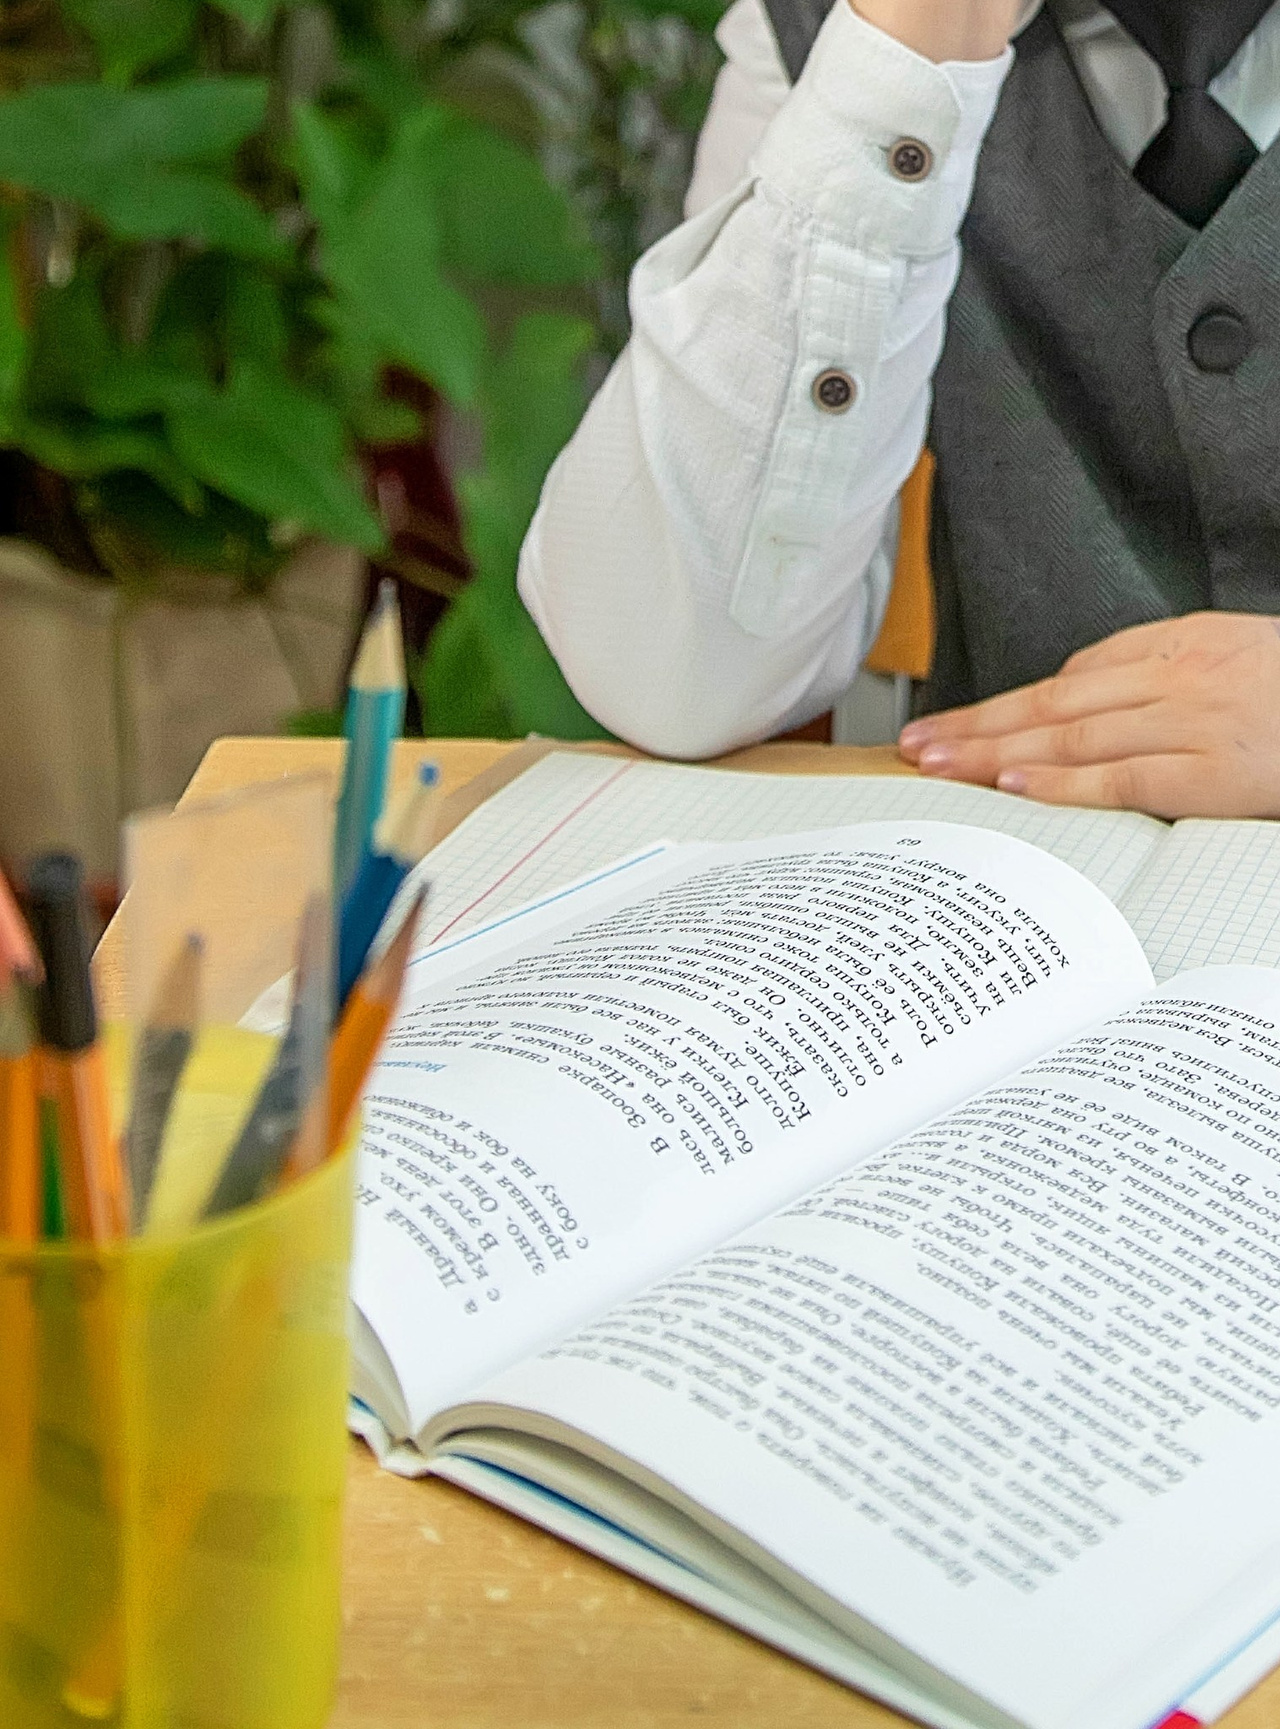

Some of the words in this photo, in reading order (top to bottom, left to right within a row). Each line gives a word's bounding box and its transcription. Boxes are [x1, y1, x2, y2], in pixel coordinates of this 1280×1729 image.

[896, 838, 922, 847] 63
[815, 859, 859, 868] была
[862, 861, 934, 884] Копуша
[903, 858, 968, 881] вокруг
[758, 892, 802, 901] раза
[841, 880, 915, 907] Копуша
[936, 880, 950, 888] а
[974, 882, 1007, 904] она
[807, 897, 879, 921] первого
[825, 889, 919, 925] положили
[889, 877, 994, 936] незнакомая,
[956, 887, 1022, 936] укусит,
[761, 912, 831, 933] достать
[814, 911, 880, 939] вышло
[924, 905, 998, 966] Копушу.
[704, 938, 757, 954] сопел.
[835, 931, 886, 962] улей,
[883, 941, 908, 957] не
[887, 924, 931, 952] Для
[926, 925, 984, 978] землю,
[1013, 907, 1070, 969] ходила
[677, 959, 701, 968] не
[772, 941, 820, 964] тоже
[825, 944, 872, 977] была
[997, 938, 1038, 989] Вещь
[1024, 945, 1051, 978] чит,
[601, 963, 725, 991] медвежонком
[623, 974, 640, 982] и
[705, 966, 758, 986] даже
[759, 952, 830, 990] сердито
[999, 970, 1022, 995] ли
[638, 977, 709, 1002] старый
[750, 964, 851, 1032] приглашая
[758, 986, 786, 1006] Он
[825, 963, 897, 1026] Копуша
[871, 978, 896, 995] её
[888, 963, 955, 1035] открыть
[911, 960, 972, 1026] съёмки
[940, 957, 991, 1017] учить.
[985, 981, 1006, 1006] на
[540, 1001, 589, 1014] были
[581, 993, 682, 1027] поместили
[591, 1008, 624, 1021] все
[710, 1000, 751, 1026] был
[743, 997, 774, 1021] что
[832, 991, 890, 1049] только
[1135, 1008, 1232, 1029] вырывала
[1205, 1004, 1275, 1030] отняли
[482, 1032, 504, 1041] В
[625, 1019, 662, 1036] нас
[900, 999, 938, 1048] Роль
[662, 1037, 676, 1046] у
[684, 1026, 747, 1070] думая
[797, 1008, 867, 1087] отлично.
[1109, 1038, 1166, 1053] вниз!
[1194, 1028, 1234, 1047] Вся
[469, 1042, 550, 1064] снимали
[624, 1033, 678, 1071] ёжик.
[752, 1026, 807, 1077] Ёжик
[784, 1022, 849, 1098] сказать,
[856, 1035, 885, 1076] она,
[891, 1052, 903, 1066] а
[1113, 1050, 1145, 1063] что
[599, 1044, 673, 1089] разные
[680, 1046, 750, 1110] Клетки
[1154, 1061, 1202, 1085] Зато
[744, 1040, 812, 1122] Копуше.
[1103, 1076, 1137, 1090] все
[1138, 1069, 1224, 1111] команде,
[557, 1065, 647, 1129] Зоопарке
[641, 1092, 675, 1124] она
[746, 1075, 796, 1130] долго
[1143, 1087, 1229, 1132] вылезла,
[454, 1120, 474, 1132] и
[677, 1070, 754, 1155] большой
[1225, 1109, 1252, 1125] по
[676, 1093, 735, 1165] мались
[386, 1133, 459, 1174] крепко
[472, 1130, 510, 1157] бок
[650, 1136, 670, 1154] В
[679, 1129, 716, 1175] лась
[396, 1157, 444, 1188] день
[477, 1160, 497, 1175] и
[510, 1156, 537, 1179] на
[457, 1174, 499, 1213] Они
[438, 1190, 483, 1229] этот
[495, 1175, 571, 1261] дранная
[534, 1184, 578, 1233] боку
[384, 1207, 467, 1289] Драный
[419, 1202, 490, 1281] кремом
[477, 1231, 500, 1253] В
[575, 1236, 589, 1250] с
[464, 1298, 479, 1315] а
[486, 1287, 501, 1302] с
